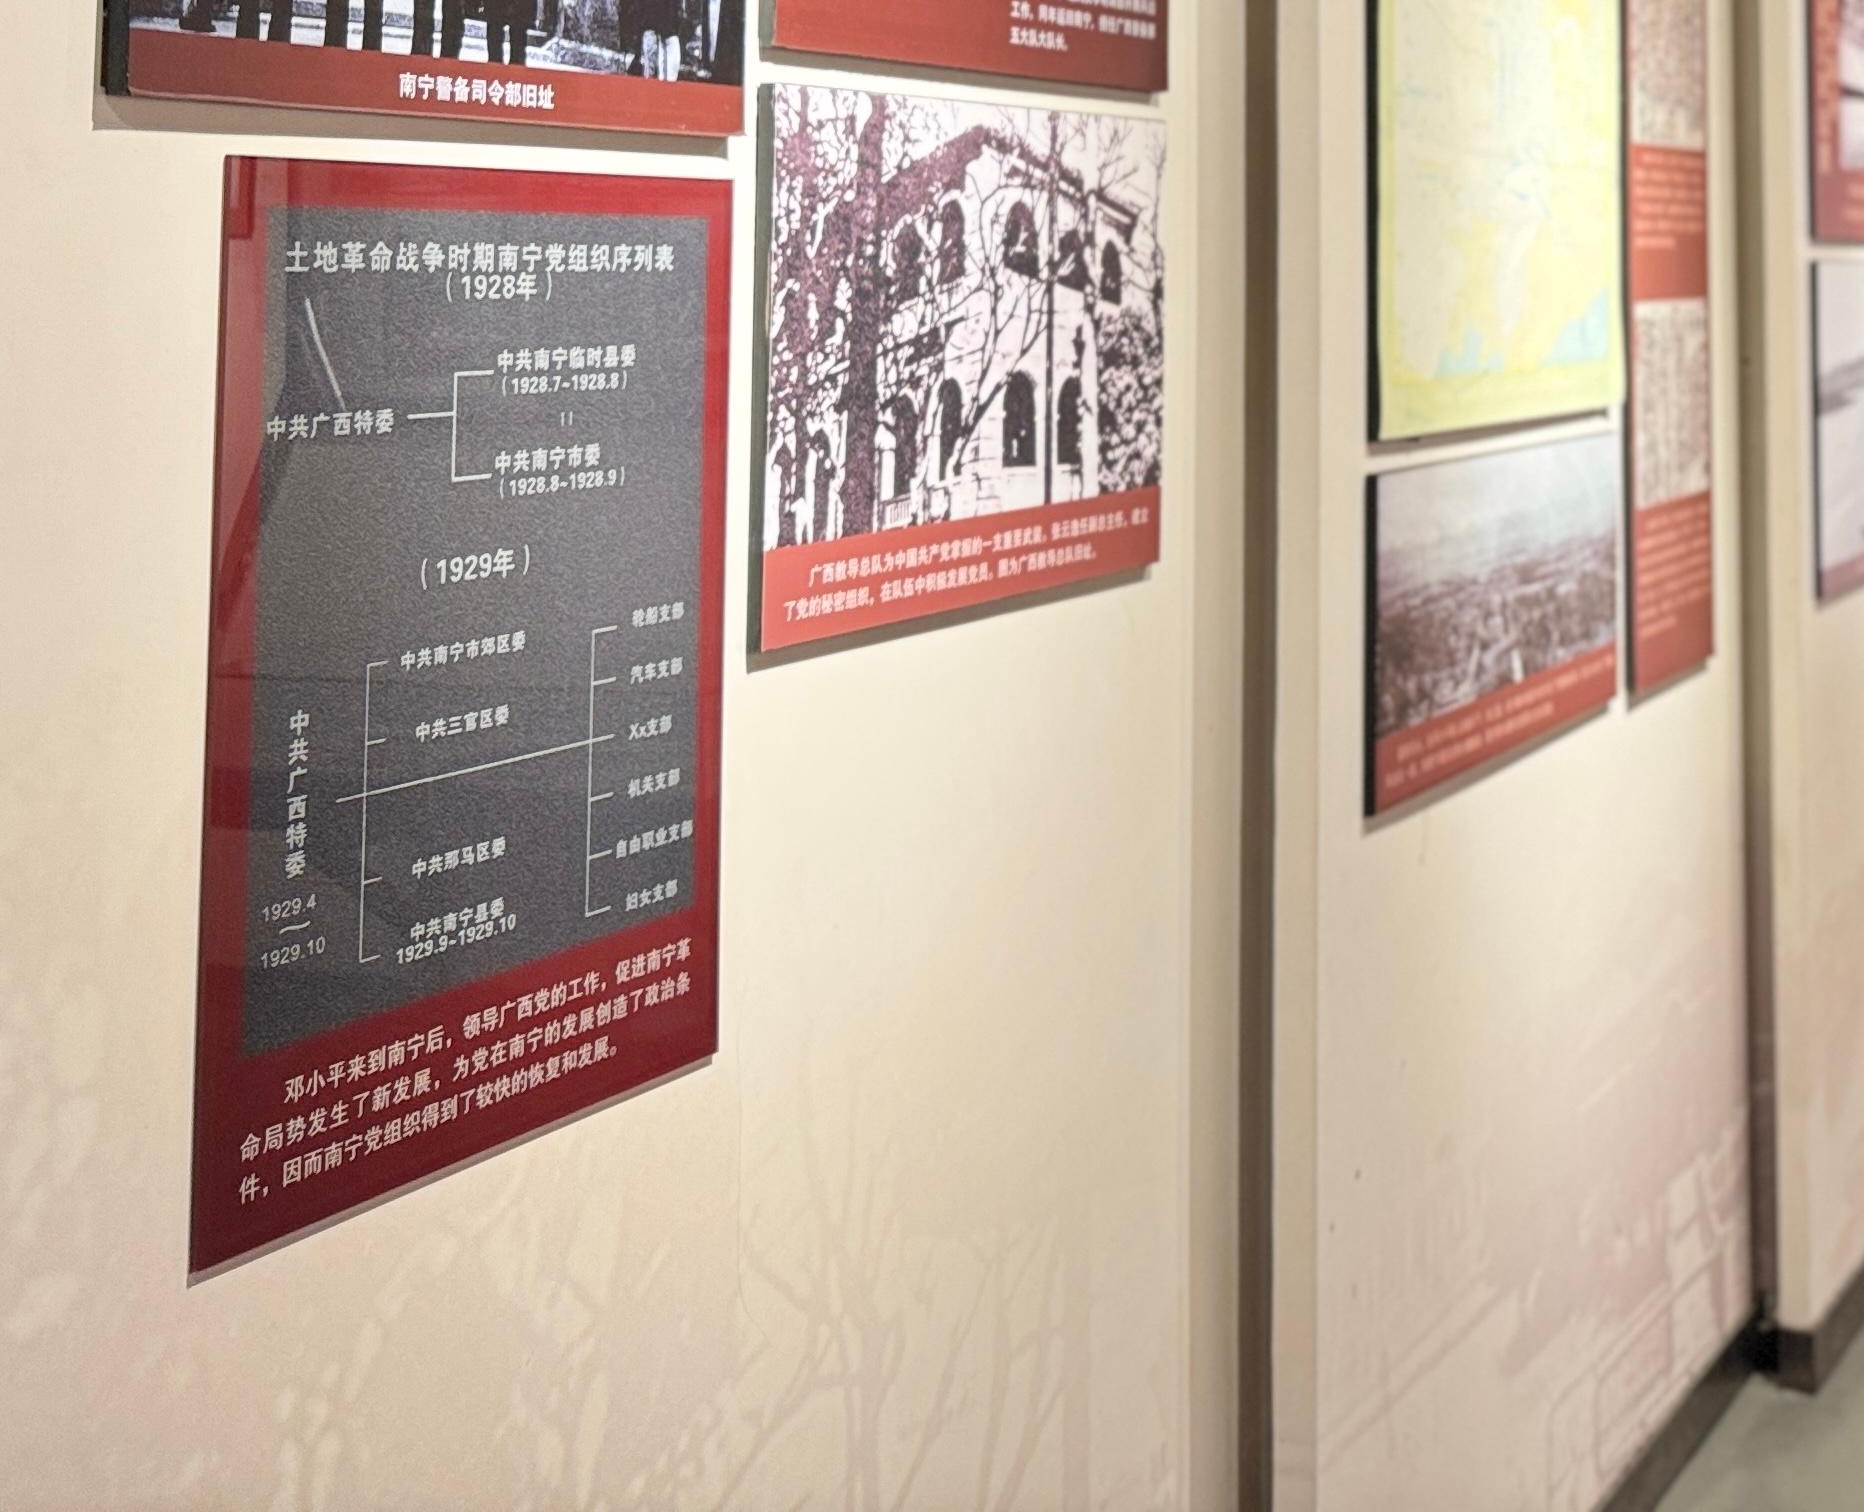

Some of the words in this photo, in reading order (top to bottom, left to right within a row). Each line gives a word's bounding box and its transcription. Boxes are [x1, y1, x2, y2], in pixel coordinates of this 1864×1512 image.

[399, 71, 555, 110] 南宁警备司令部旧址
[285, 241, 675, 274] 土地革命战争时期南宁党组织序列表
[446, 271, 552, 302] （1928年）
[497, 344, 636, 373] 中共南宁临时县委
[266, 408, 394, 441] 中共广西特委
[495, 443, 601, 475] 中共南宁市委
[420, 544, 531, 590] （1929年）
[400, 630, 526, 672] 中共南宁市郊区委
[630, 657, 683, 685] 汽车支部
[285, 709, 310, 879] 中共广西特委
[628, 768, 680, 799] 机关支部
[616, 819, 693, 859] 自由职业支部
[412, 836, 506, 880] 中共那马区委
[262, 893, 316, 923] 1929.4
[625, 879, 678, 911] 妇女支部
[410, 897, 504, 942] 中共南宁县委
[261, 936, 326, 970] 1929.10
[284, 937, 693, 1105] 邓小平来到南宁后，领导广西党的工作，促进南宁革
[239, 972, 692, 1163] 命局势发生了新发展，为党在南宁的发展创造了政治条
[238, 1036, 618, 1206] 件，因而南宁党组织得到了较快的恢复和发展。
